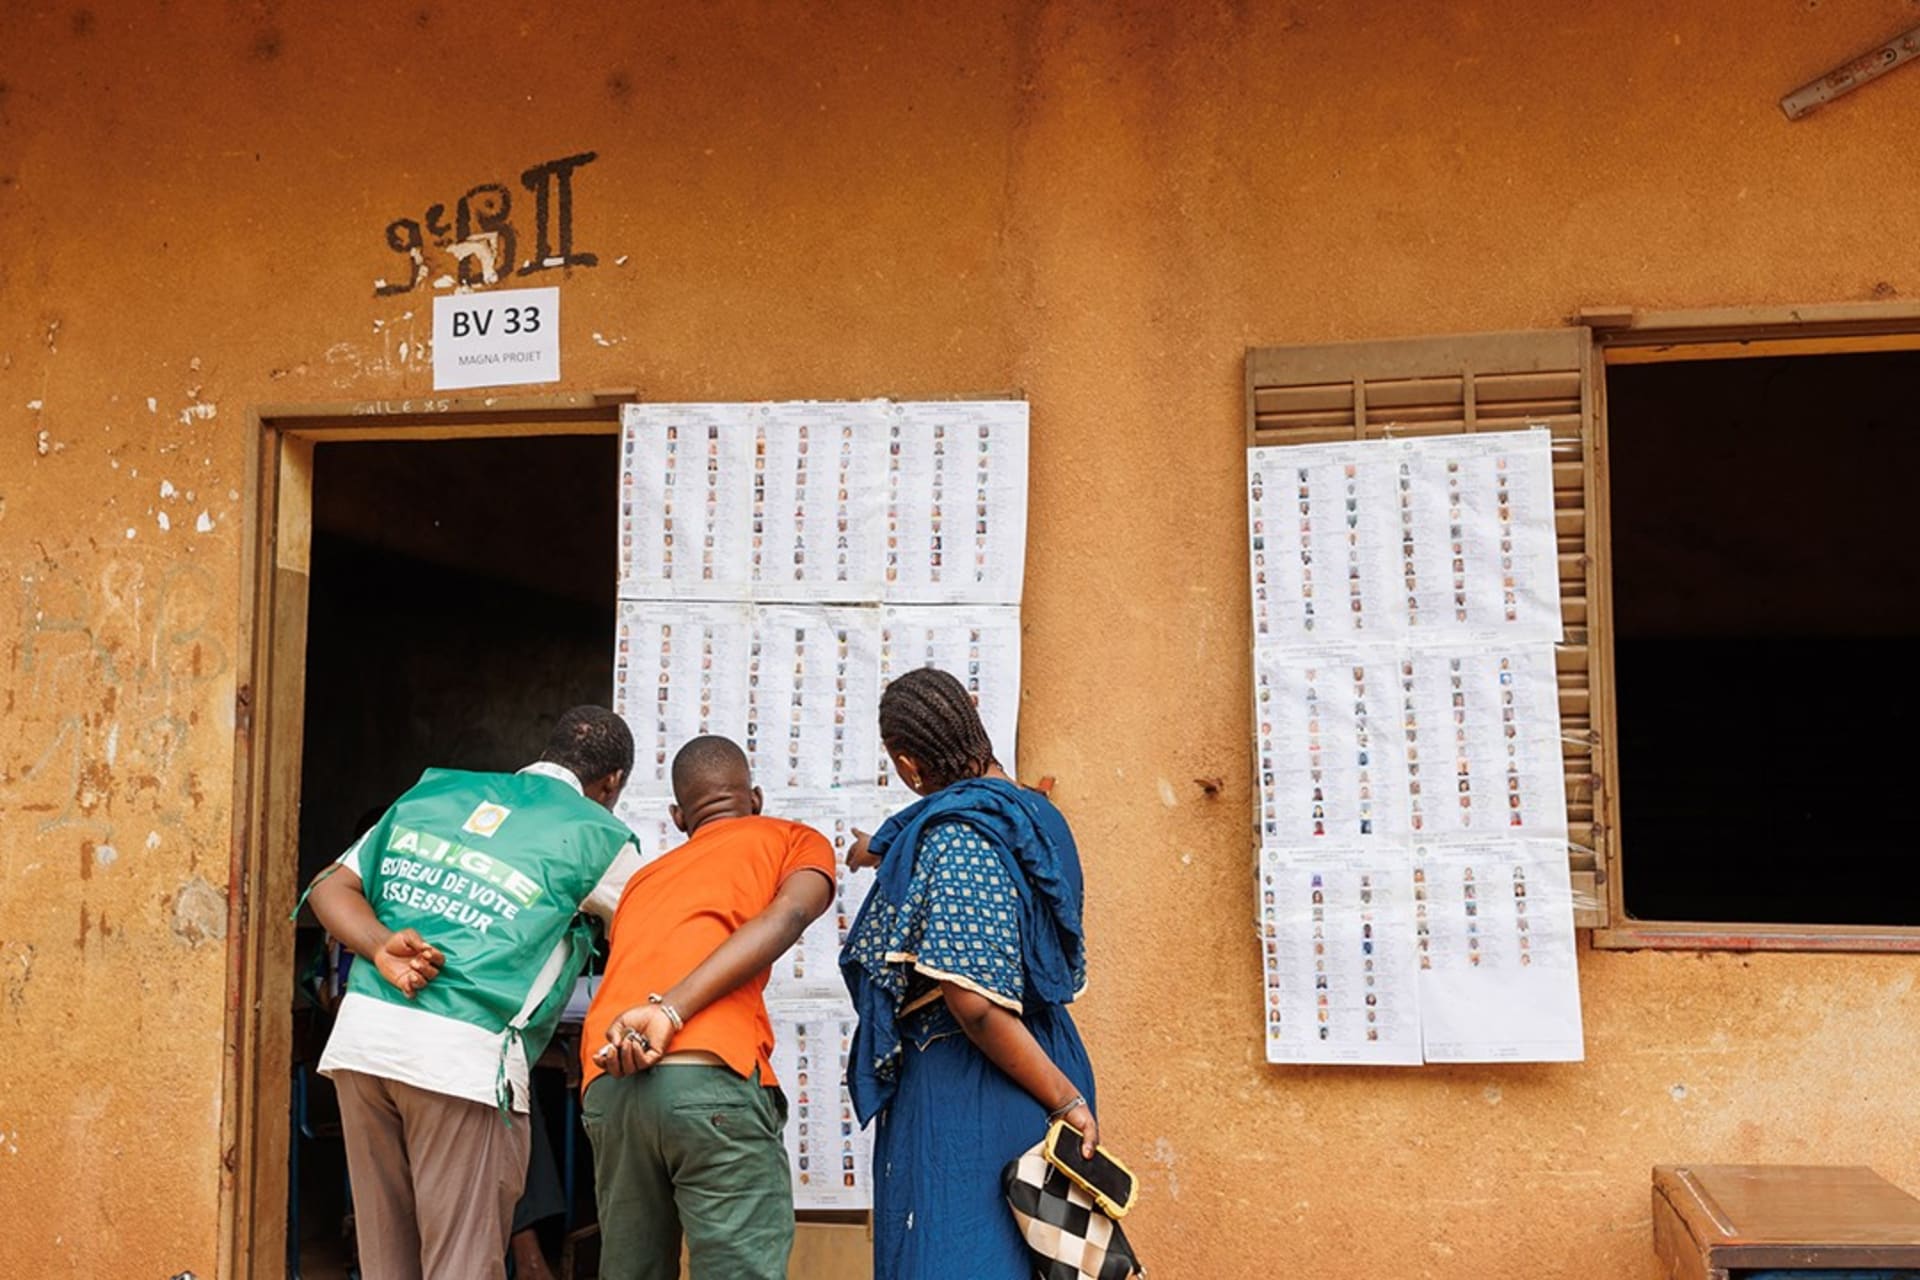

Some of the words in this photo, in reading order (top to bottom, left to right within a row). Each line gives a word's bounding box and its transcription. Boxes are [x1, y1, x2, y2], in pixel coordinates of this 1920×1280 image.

[452, 308, 494, 338] BV
[503, 305, 541, 335] 33
[458, 353, 500, 366] MAGNA
[502, 351, 542, 363] PROJET
[380, 856, 443, 887] BUREAU
[441, 871, 470, 895] DE
[467, 881, 520, 921] VOTE
